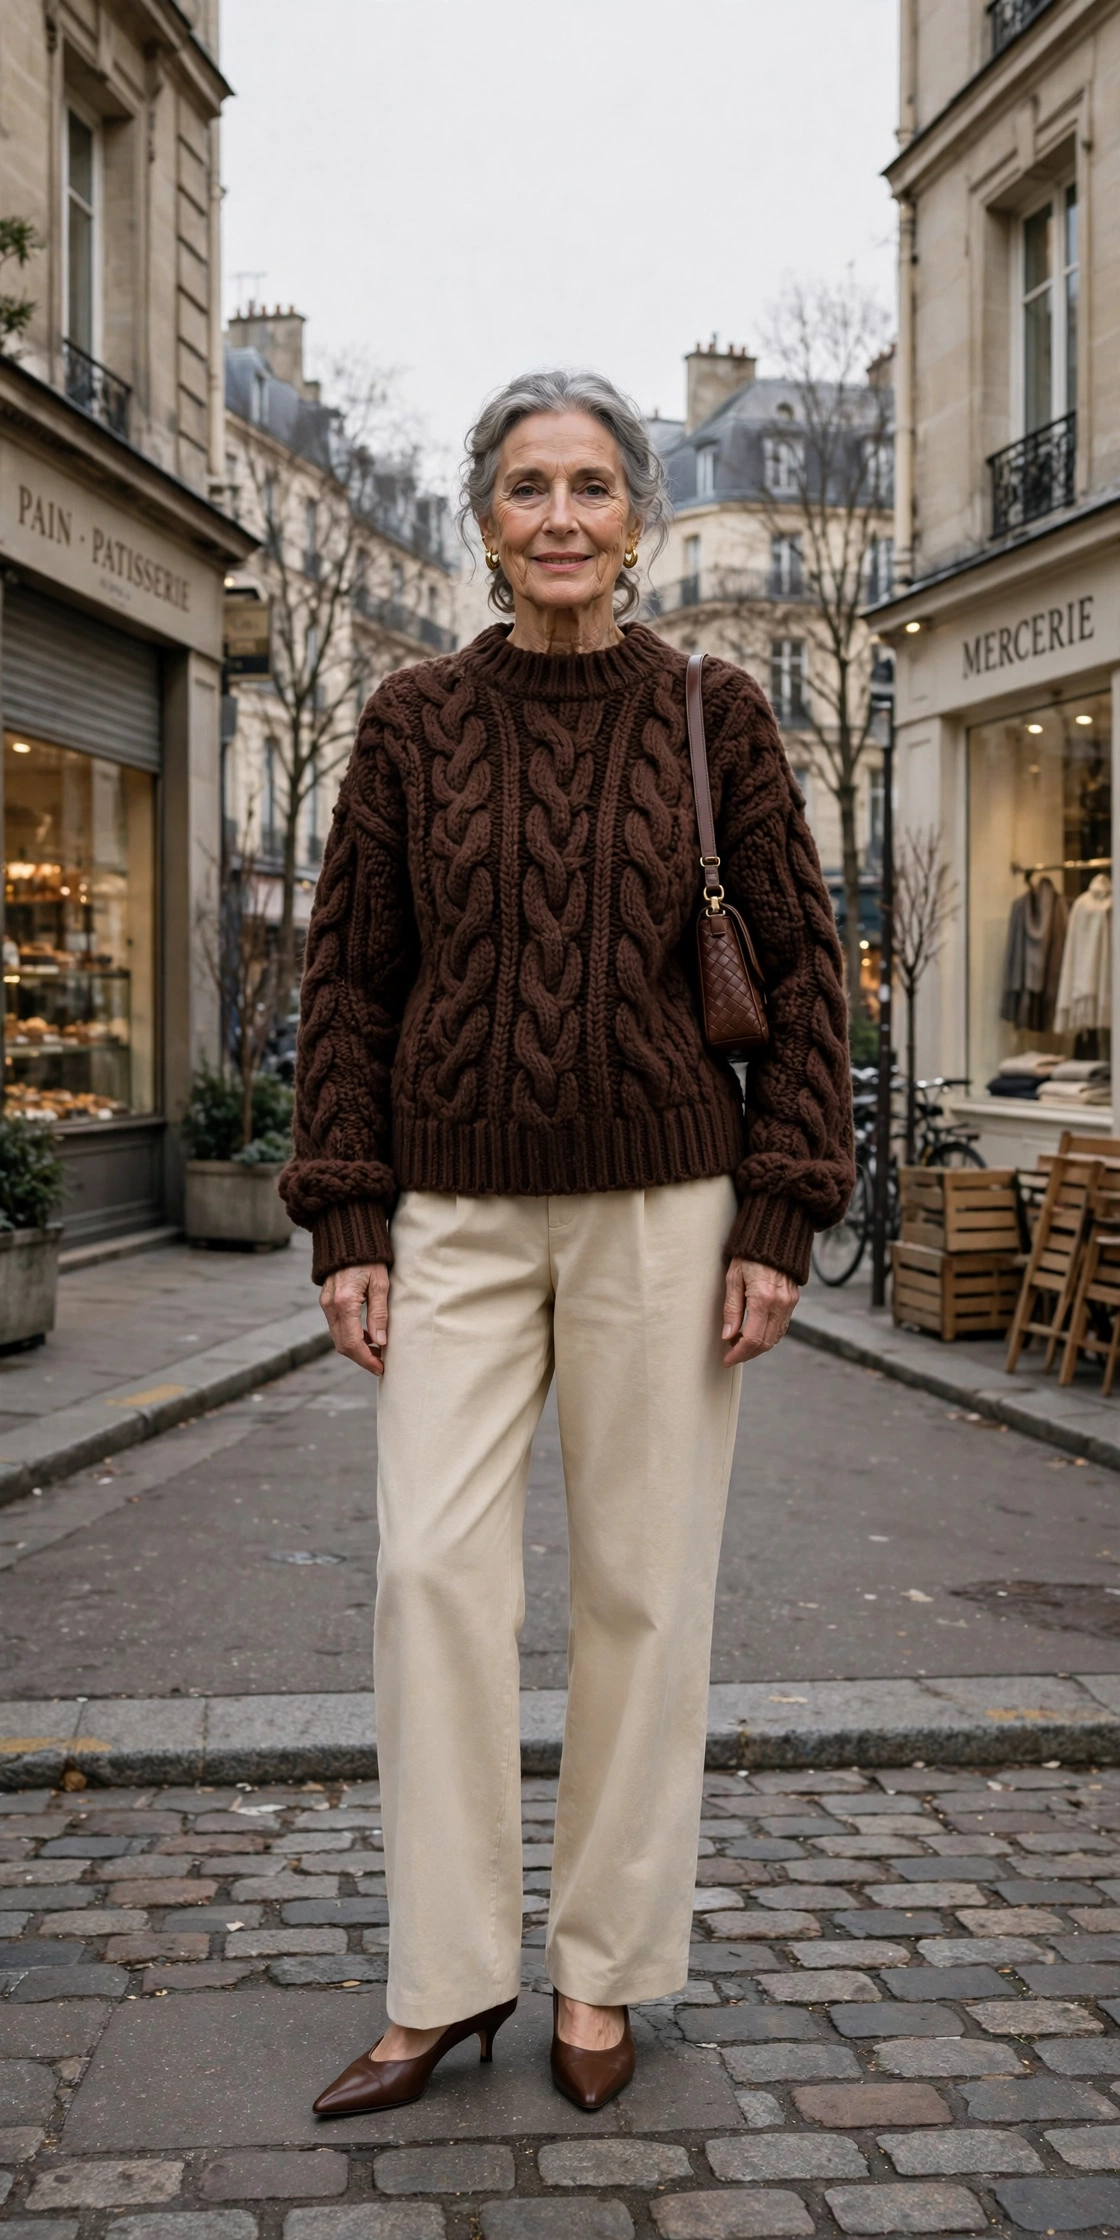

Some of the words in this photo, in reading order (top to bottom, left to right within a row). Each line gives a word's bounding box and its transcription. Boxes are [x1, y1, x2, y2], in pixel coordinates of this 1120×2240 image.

[18, 484, 72, 547] PAIN
[92, 527, 191, 613] PATISSERIE
[962, 596, 1095, 680] MERCERIE
